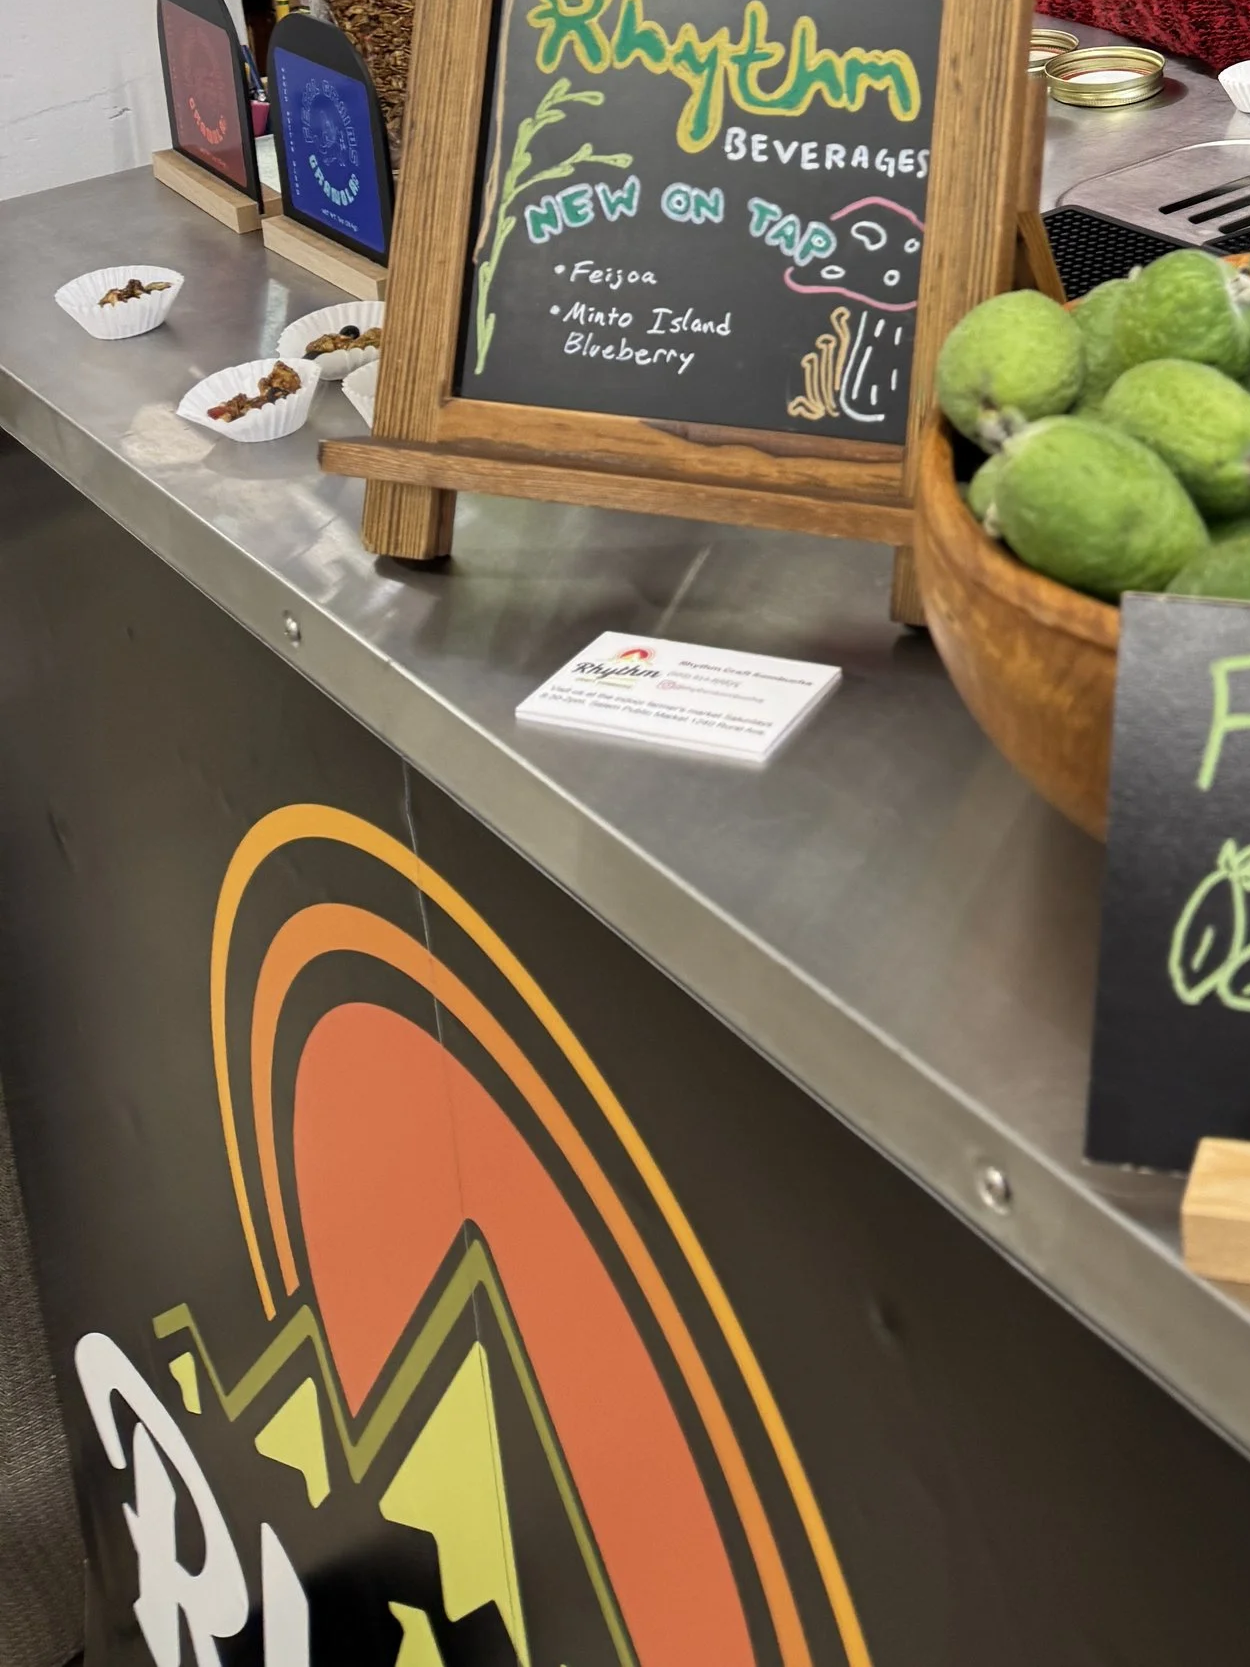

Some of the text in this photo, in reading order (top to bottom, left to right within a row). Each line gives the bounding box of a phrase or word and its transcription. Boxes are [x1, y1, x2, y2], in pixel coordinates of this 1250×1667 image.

[724, 126, 929, 179] BEVERAGES
[524, 175, 838, 268] NEW ON TAP
[568, 260, 658, 290] Feijoa
[561, 301, 733, 338] Minto Island
[564, 333, 696, 372] Blueberry
[571, 661, 661, 680] Rhythm
